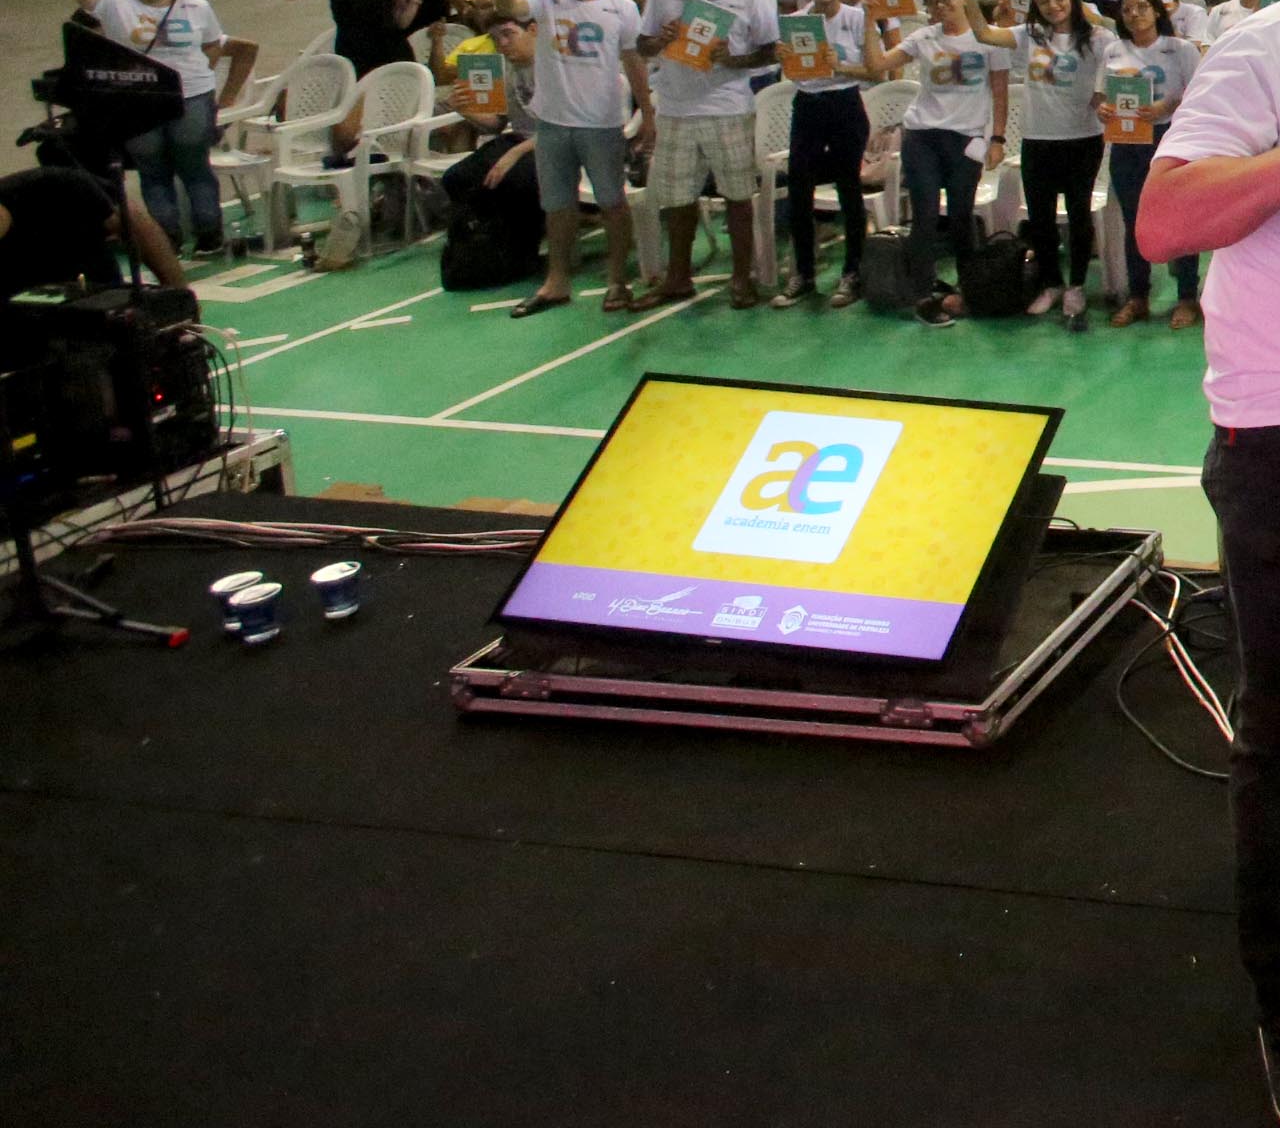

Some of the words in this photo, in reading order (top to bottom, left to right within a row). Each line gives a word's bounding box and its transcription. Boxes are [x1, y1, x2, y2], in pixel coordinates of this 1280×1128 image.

[724, 515, 790, 531] academia
[793, 522, 831, 534] enem
[721, 606, 765, 617] SINDI
